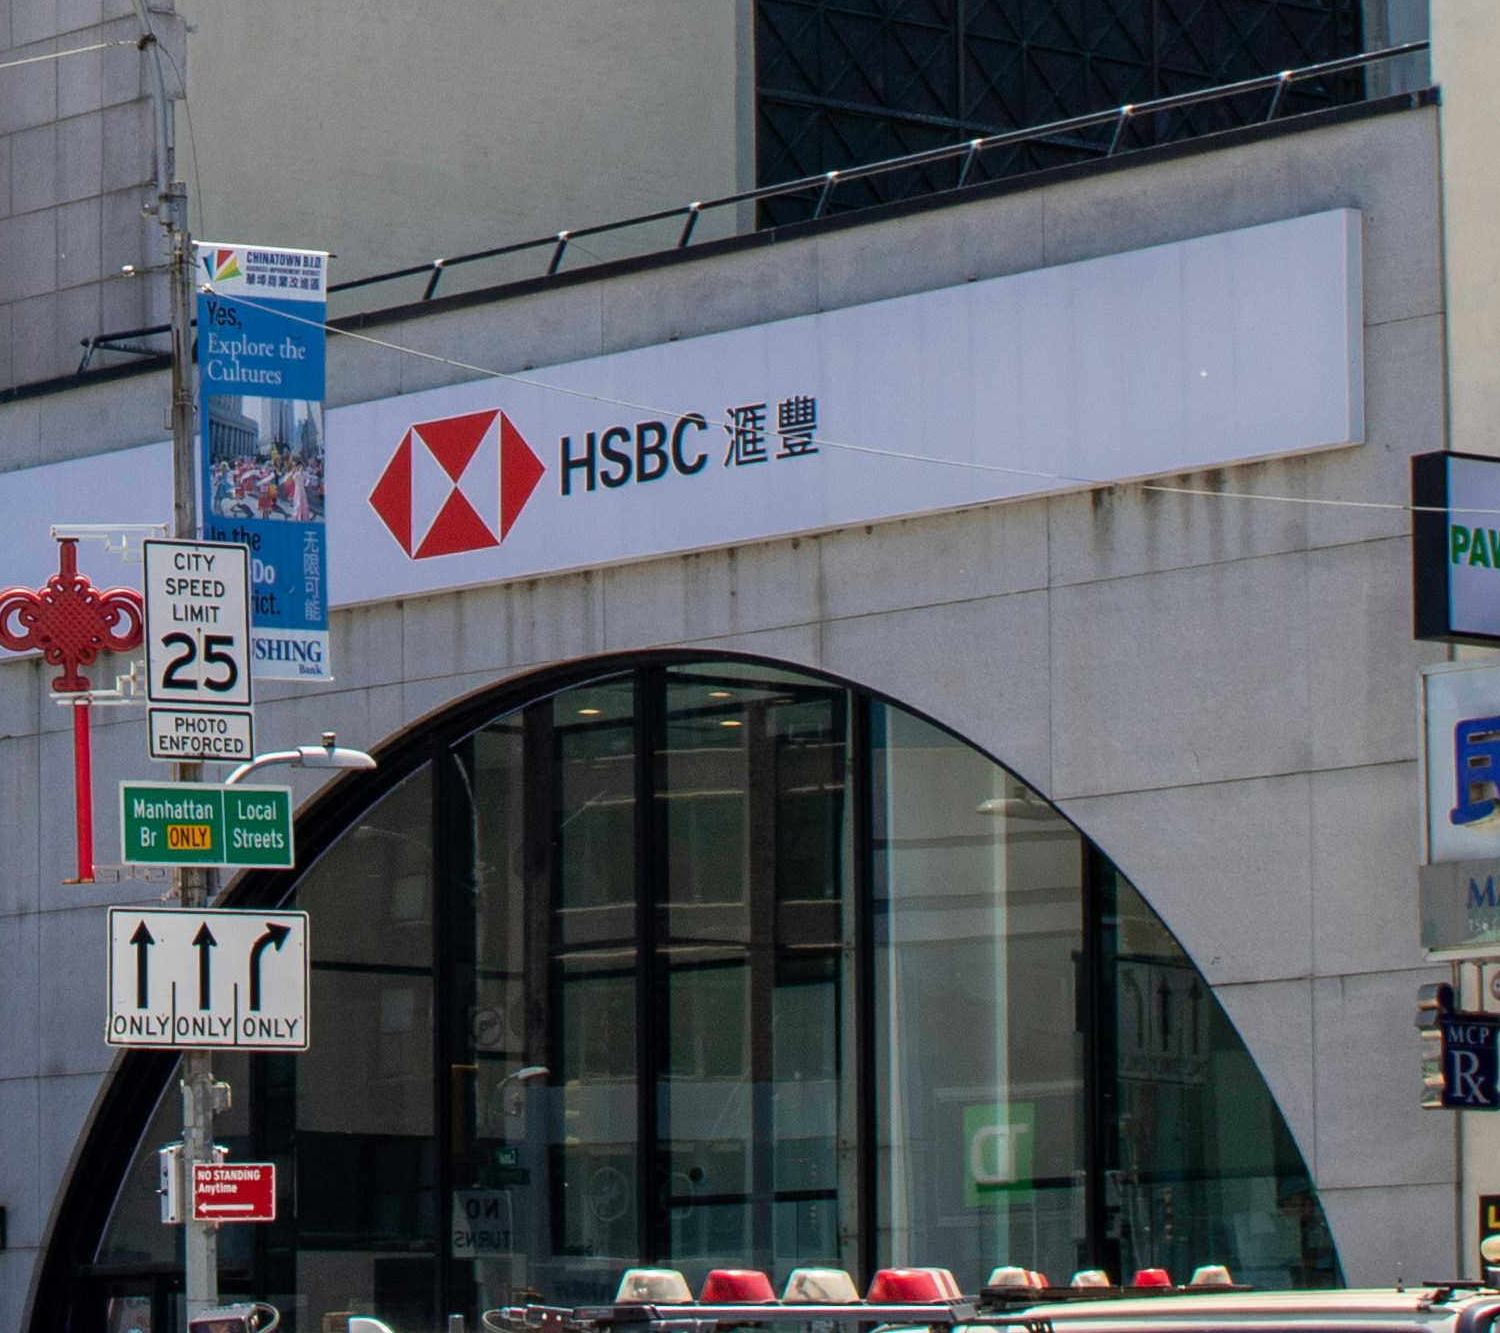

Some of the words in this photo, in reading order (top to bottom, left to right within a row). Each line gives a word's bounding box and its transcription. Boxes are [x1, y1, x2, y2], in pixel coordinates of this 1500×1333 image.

[246, 251, 300, 267] CHINATOWN
[207, 300, 242, 330] Yes,
[208, 332, 275, 361] Explore
[279, 336, 306, 359] the
[207, 359, 282, 384] Cultures
[559, 412, 708, 496] HSBC
[173, 552, 216, 572] CITY
[303, 530, 321, 622] 无限可能
[165, 578, 226, 598] SPEED
[172, 603, 221, 624] LIMIT
[161, 631, 239, 693] 25
[299, 664, 322, 676] Bank
[174, 716, 228, 735] PHOTO
[159, 735, 244, 754] ENFORCED
[133, 798, 214, 820] Manhattan
[238, 799, 277, 821] Local
[140, 826, 157, 847] Br
[169, 827, 209, 848] ONLY
[233, 827, 285, 849] Streets
[113, 1015, 170, 1036] ONLY
[176, 1016, 232, 1037] ONLY
[243, 1017, 298, 1039] ONLY
[1448, 1025, 1490, 1045] MCP
[198, 1169, 212, 1181] NO
[213, 1169, 261, 1181] STANDING
[198, 1183, 238, 1195] Anytime
